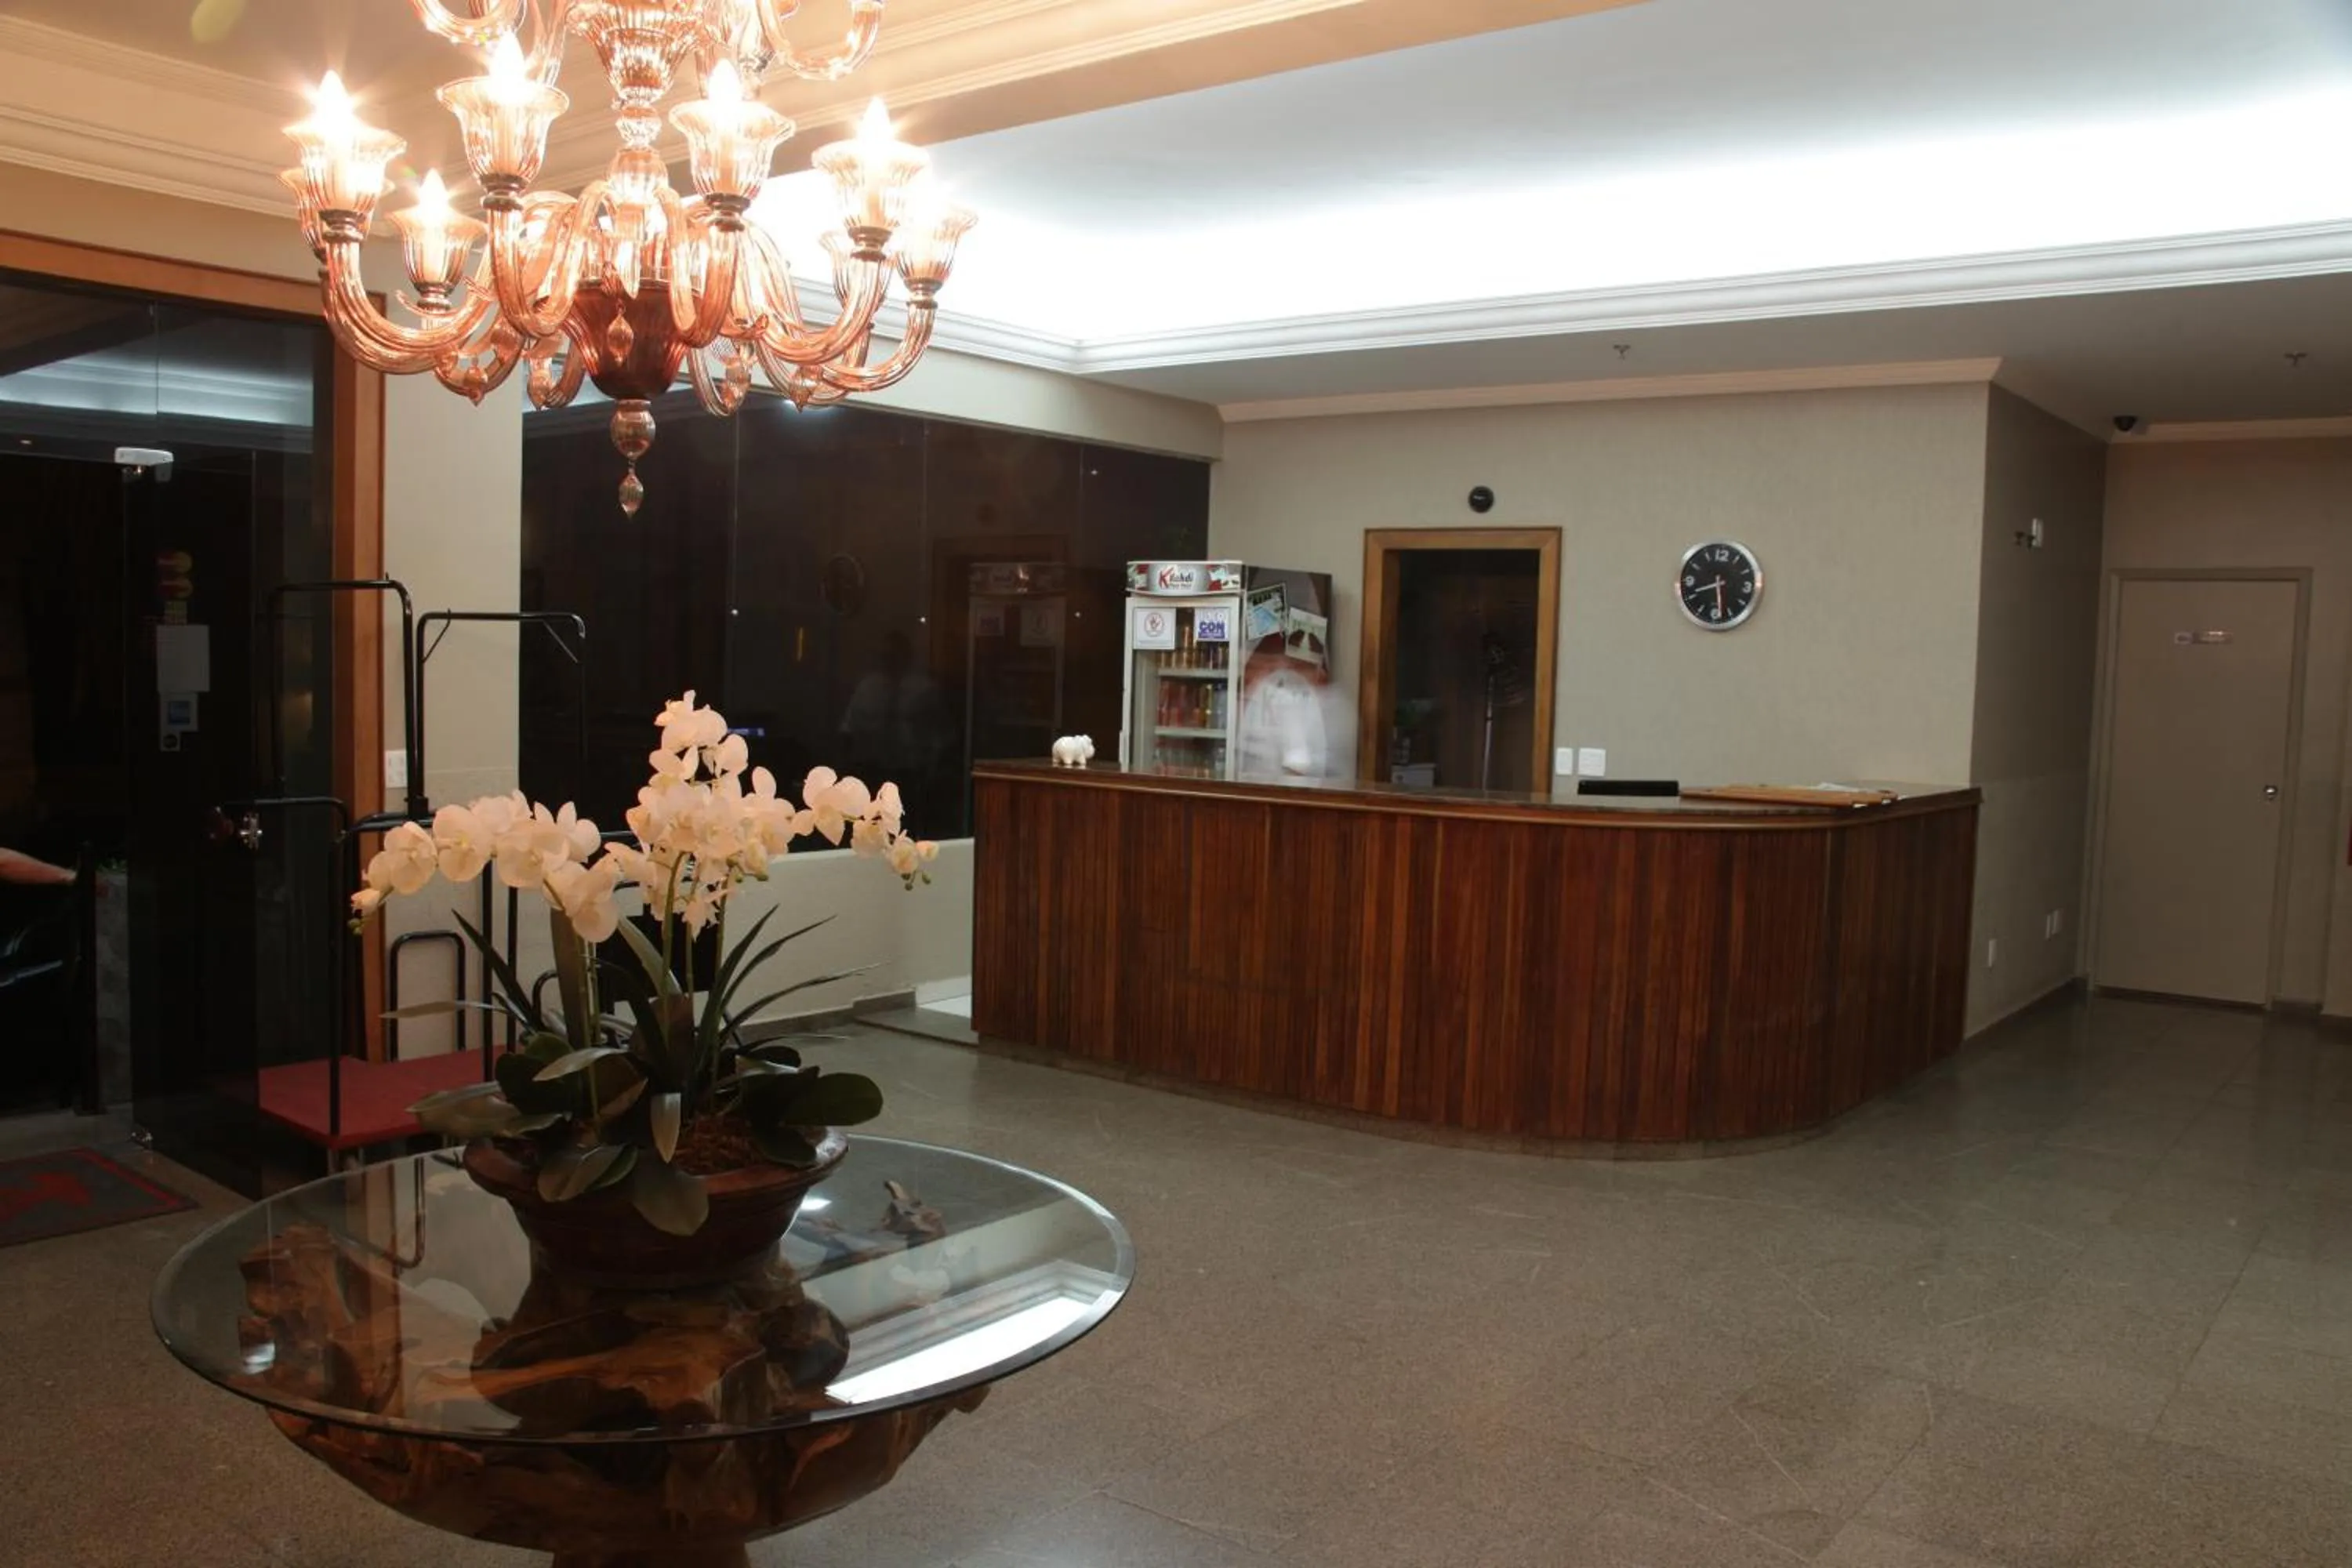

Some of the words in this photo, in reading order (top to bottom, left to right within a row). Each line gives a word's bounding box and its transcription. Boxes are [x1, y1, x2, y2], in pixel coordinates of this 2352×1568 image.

[1715, 549, 1730, 562] 12
[1686, 575, 1694, 587] 9
[1743, 581, 1752, 593] 3
